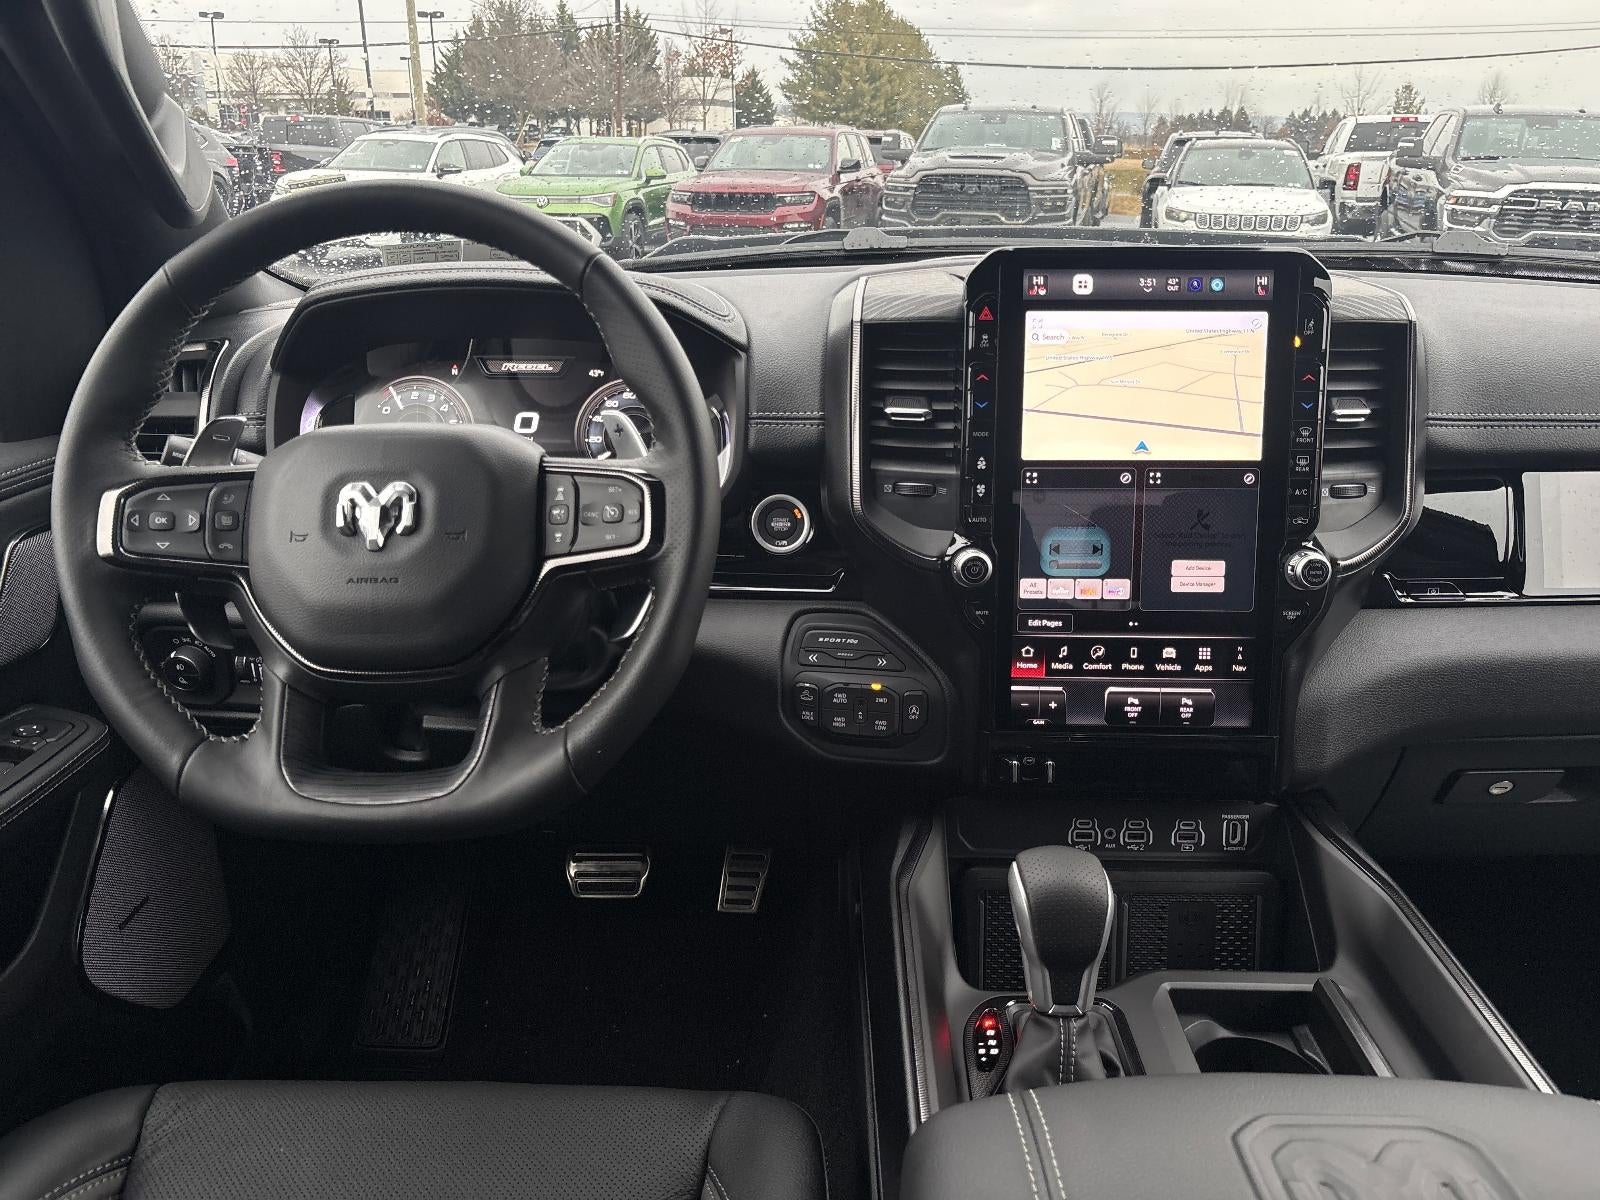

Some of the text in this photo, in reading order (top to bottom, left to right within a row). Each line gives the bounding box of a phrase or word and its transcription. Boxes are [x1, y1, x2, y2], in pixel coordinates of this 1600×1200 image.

[1032, 276, 1044, 285] HI
[1139, 278, 1157, 287] 3:51
[1256, 276, 1268, 286] HI
[1042, 333, 1065, 341] Search
[451, 368, 458, 376] N
[410, 391, 419, 399] 2
[427, 393, 436, 402] 3
[381, 406, 391, 414] 0
[439, 404, 449, 412] 4
[513, 411, 540, 434] 0
[588, 435, 603, 443] 20
[1294, 488, 1308, 496] A/C
[154, 516, 168, 525] OK
[346, 577, 399, 585] AIRBAG
[1028, 619, 1063, 629] Edit Pages
[204, 645, 216, 658] AUTO
[1016, 661, 1038, 669] Home
[1051, 662, 1074, 670] Media
[1082, 662, 1113, 670] Comfort
[1121, 663, 1145, 671] Phone
[1155, 663, 1182, 671] Vehicle
[1194, 664, 1213, 673] Apps
[1232, 664, 1247, 672] Nav
